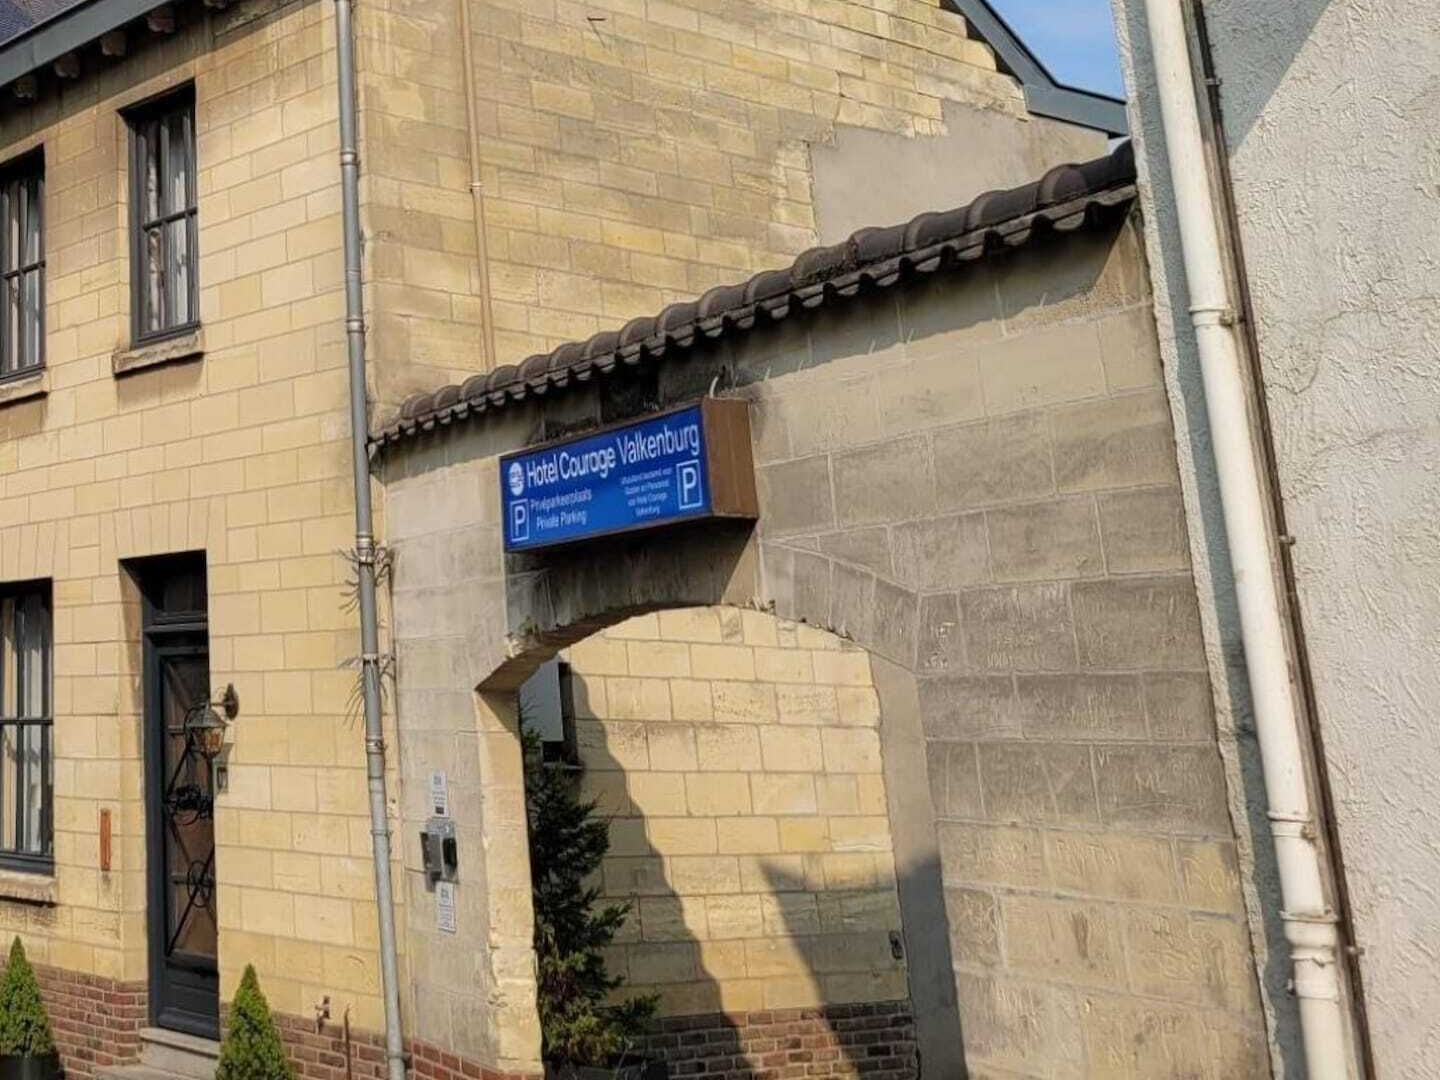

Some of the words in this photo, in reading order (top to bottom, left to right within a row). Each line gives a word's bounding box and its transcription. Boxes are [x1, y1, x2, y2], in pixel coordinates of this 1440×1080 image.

[526, 454, 559, 488] Hotel
[560, 447, 616, 478] Courage
[616, 424, 700, 465] Valkenburg
[682, 467, 697, 503] P
[514, 505, 526, 537] P
[560, 510, 587, 528] Parking
